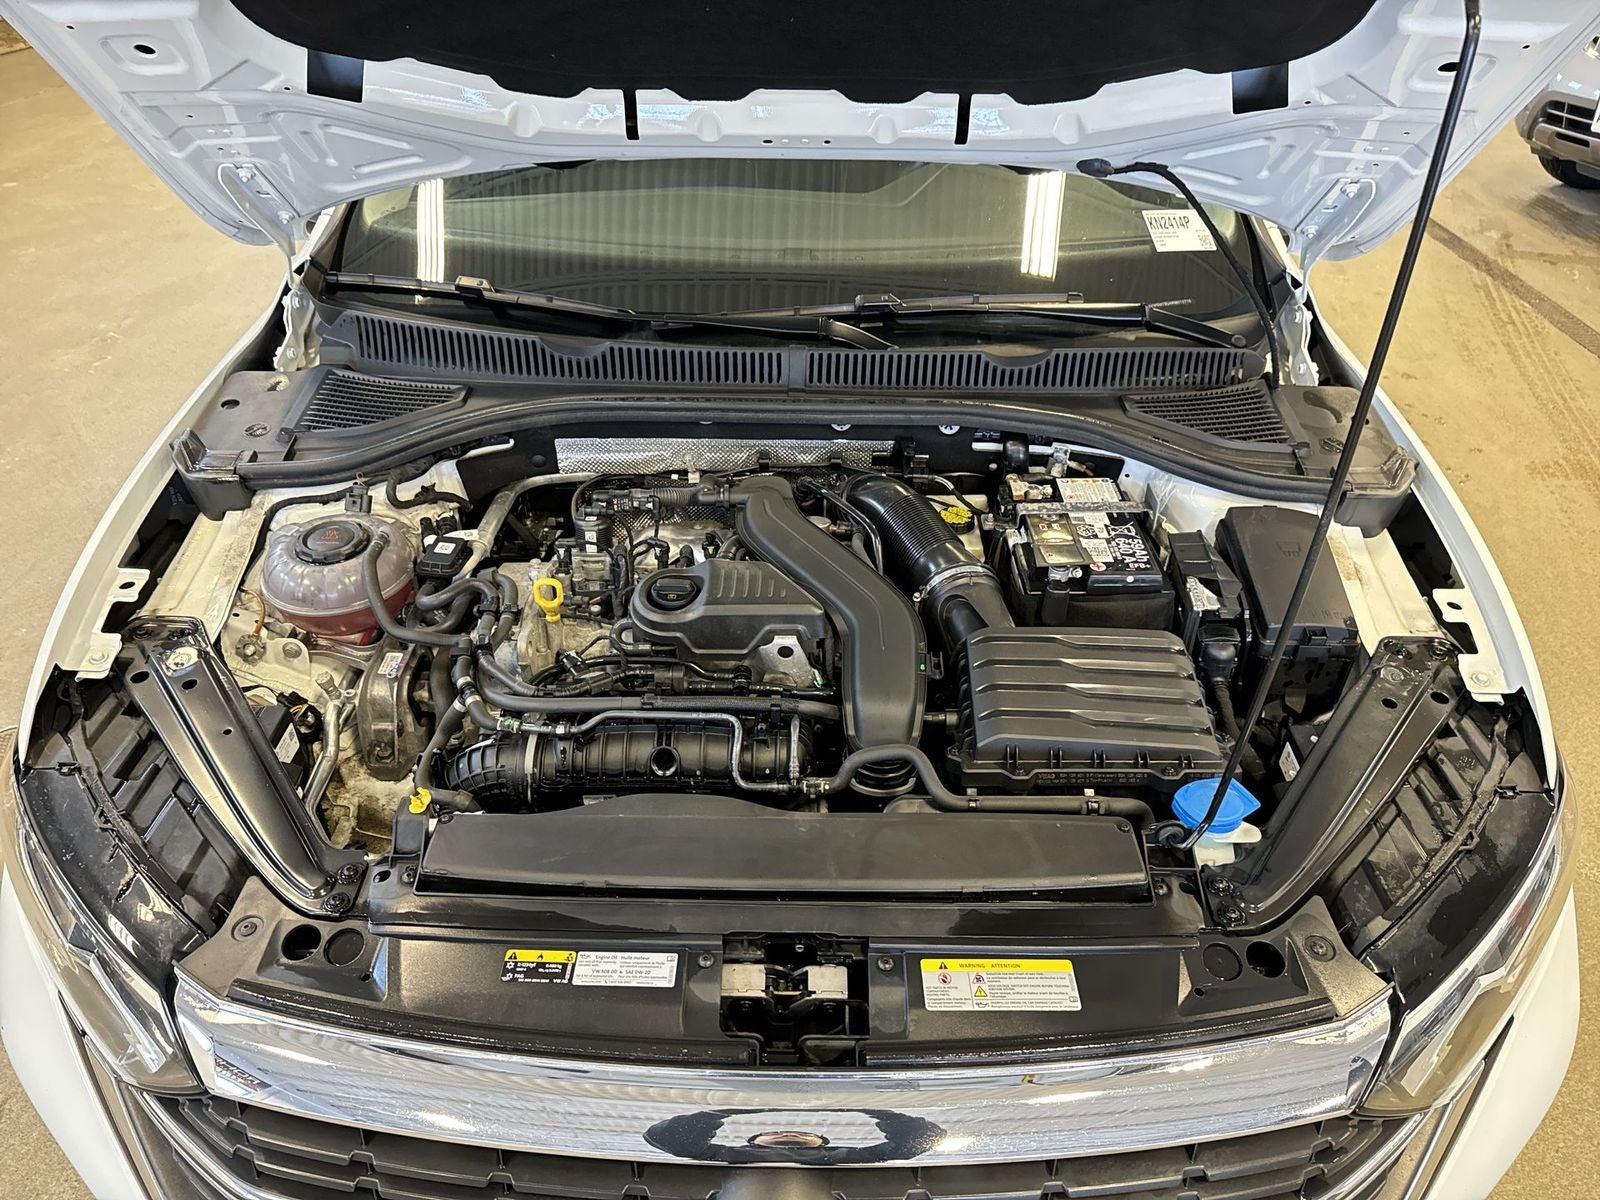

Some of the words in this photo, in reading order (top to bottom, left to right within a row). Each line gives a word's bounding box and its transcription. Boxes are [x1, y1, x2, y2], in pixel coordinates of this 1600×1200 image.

[1147, 216, 1190, 230] KN2414P
[1115, 537, 1133, 554] 640
[1128, 538, 1150, 562] 59Ah
[1123, 555, 1137, 563] A
